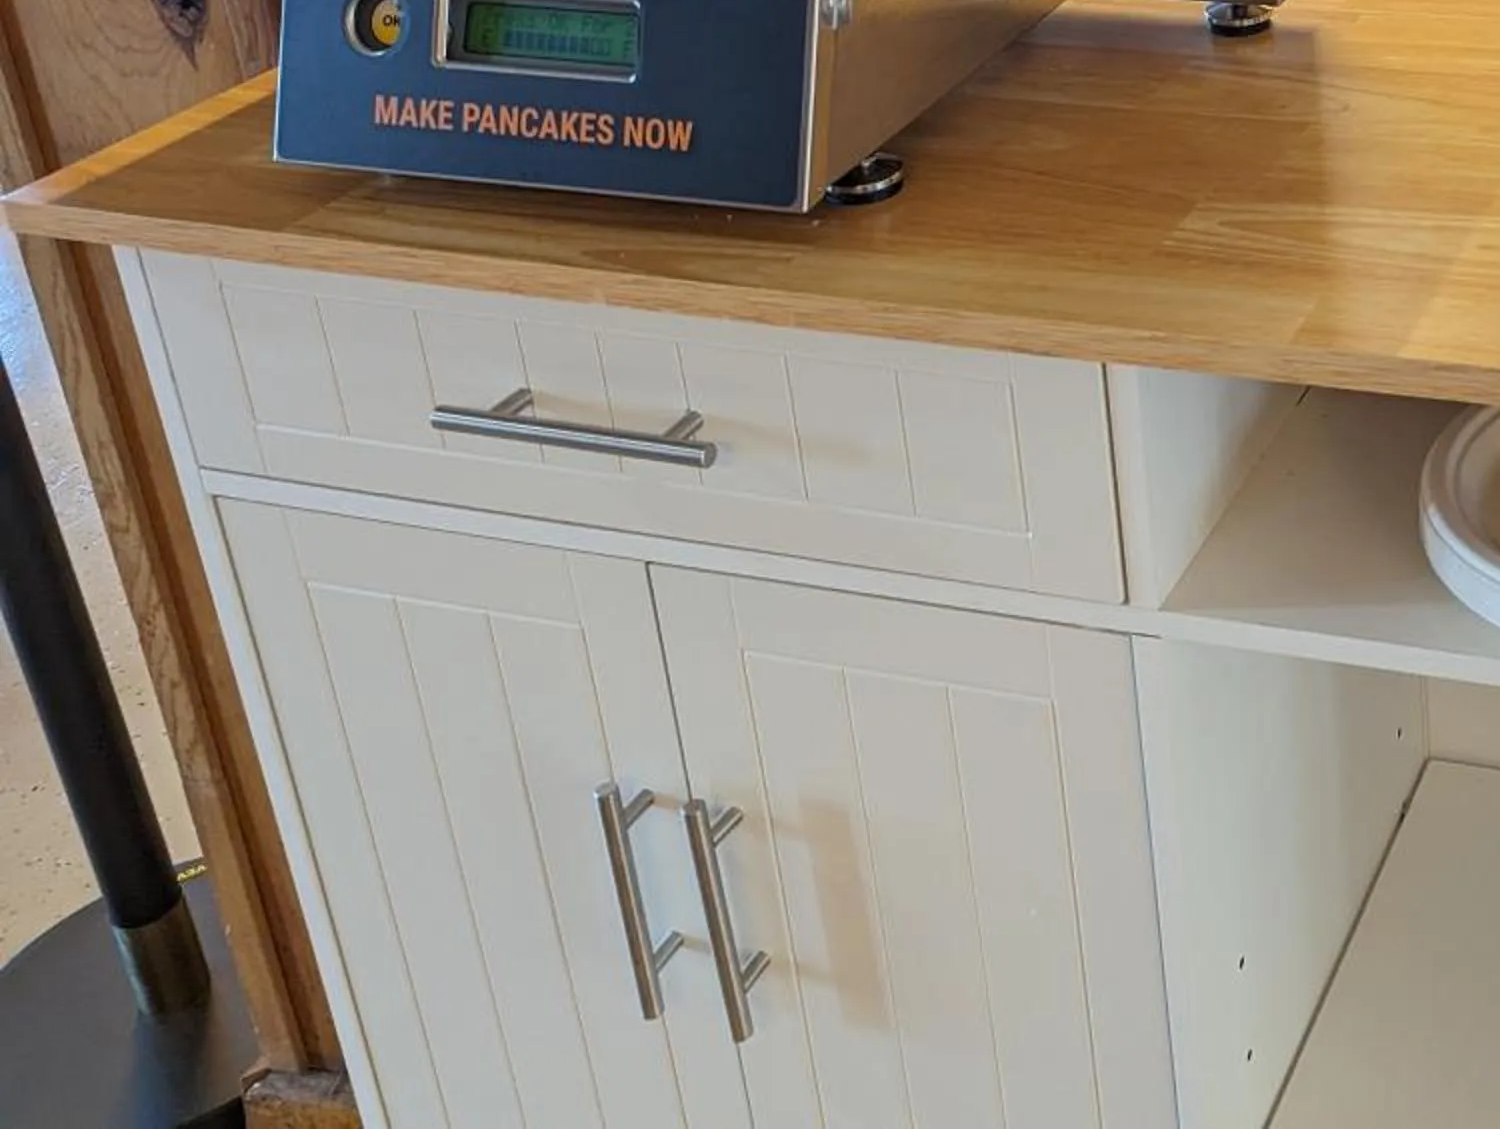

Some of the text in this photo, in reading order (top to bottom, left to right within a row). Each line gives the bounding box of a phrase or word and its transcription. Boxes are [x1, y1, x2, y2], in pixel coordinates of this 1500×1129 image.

[375, 94, 694, 152] MAKE PANCAKES NOW
